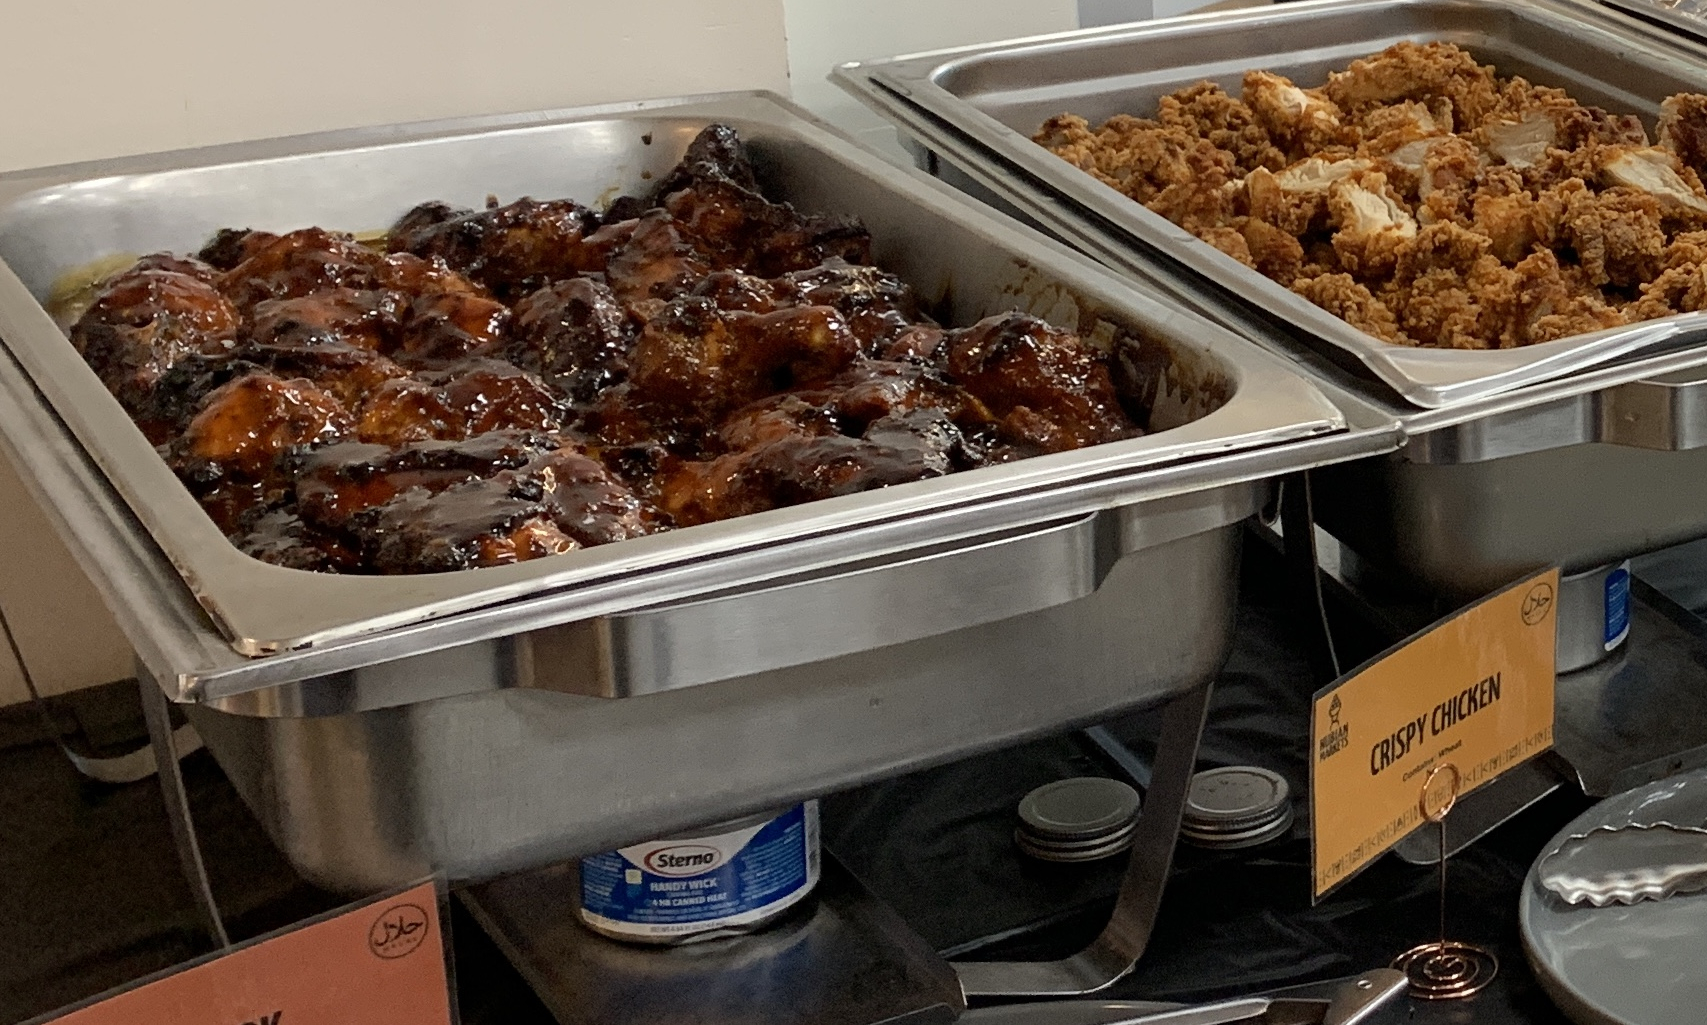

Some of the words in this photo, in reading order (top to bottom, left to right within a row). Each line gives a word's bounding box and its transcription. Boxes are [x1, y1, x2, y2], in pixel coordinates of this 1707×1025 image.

[1371, 713, 1427, 775] CRISPY
[1431, 671, 1501, 736] CHICKEN
[657, 851, 714, 869] Sterno
[650, 881, 687, 892] HANDY
[688, 877, 718, 890] WICK
